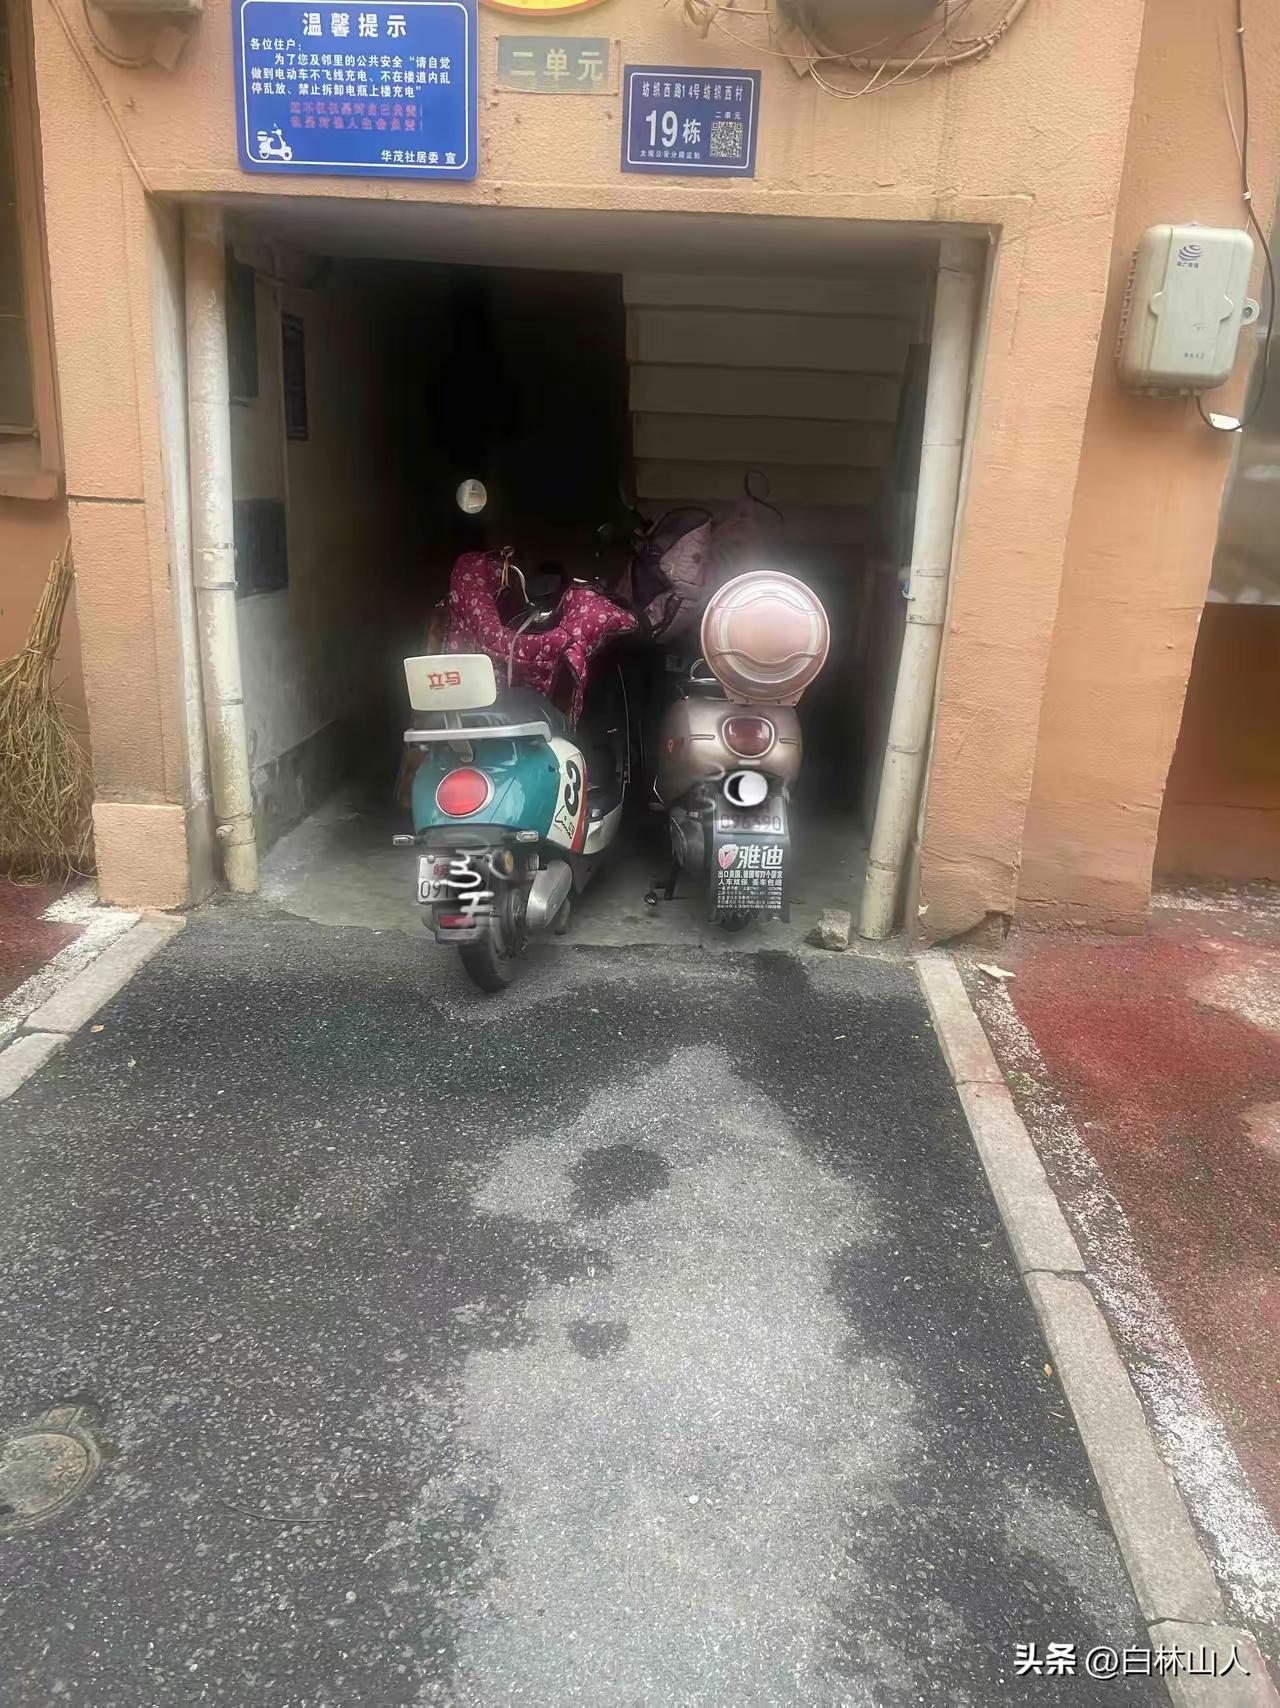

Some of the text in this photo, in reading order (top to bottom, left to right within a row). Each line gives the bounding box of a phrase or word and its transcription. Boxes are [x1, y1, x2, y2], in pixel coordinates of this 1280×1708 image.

[302, 12, 407, 38] 温馨提示
[510, 48, 603, 80] 二单元
[251, 67, 451, 84] 做到电动车不飞线充电、不在楼道内乱
[714, 111, 742, 120] 二单元
[645, 110, 702, 148] 19栋
[381, 150, 440, 164] 华茂社居委
[427, 671, 461, 690] 立马
[736, 844, 784, 869] 雅迪
